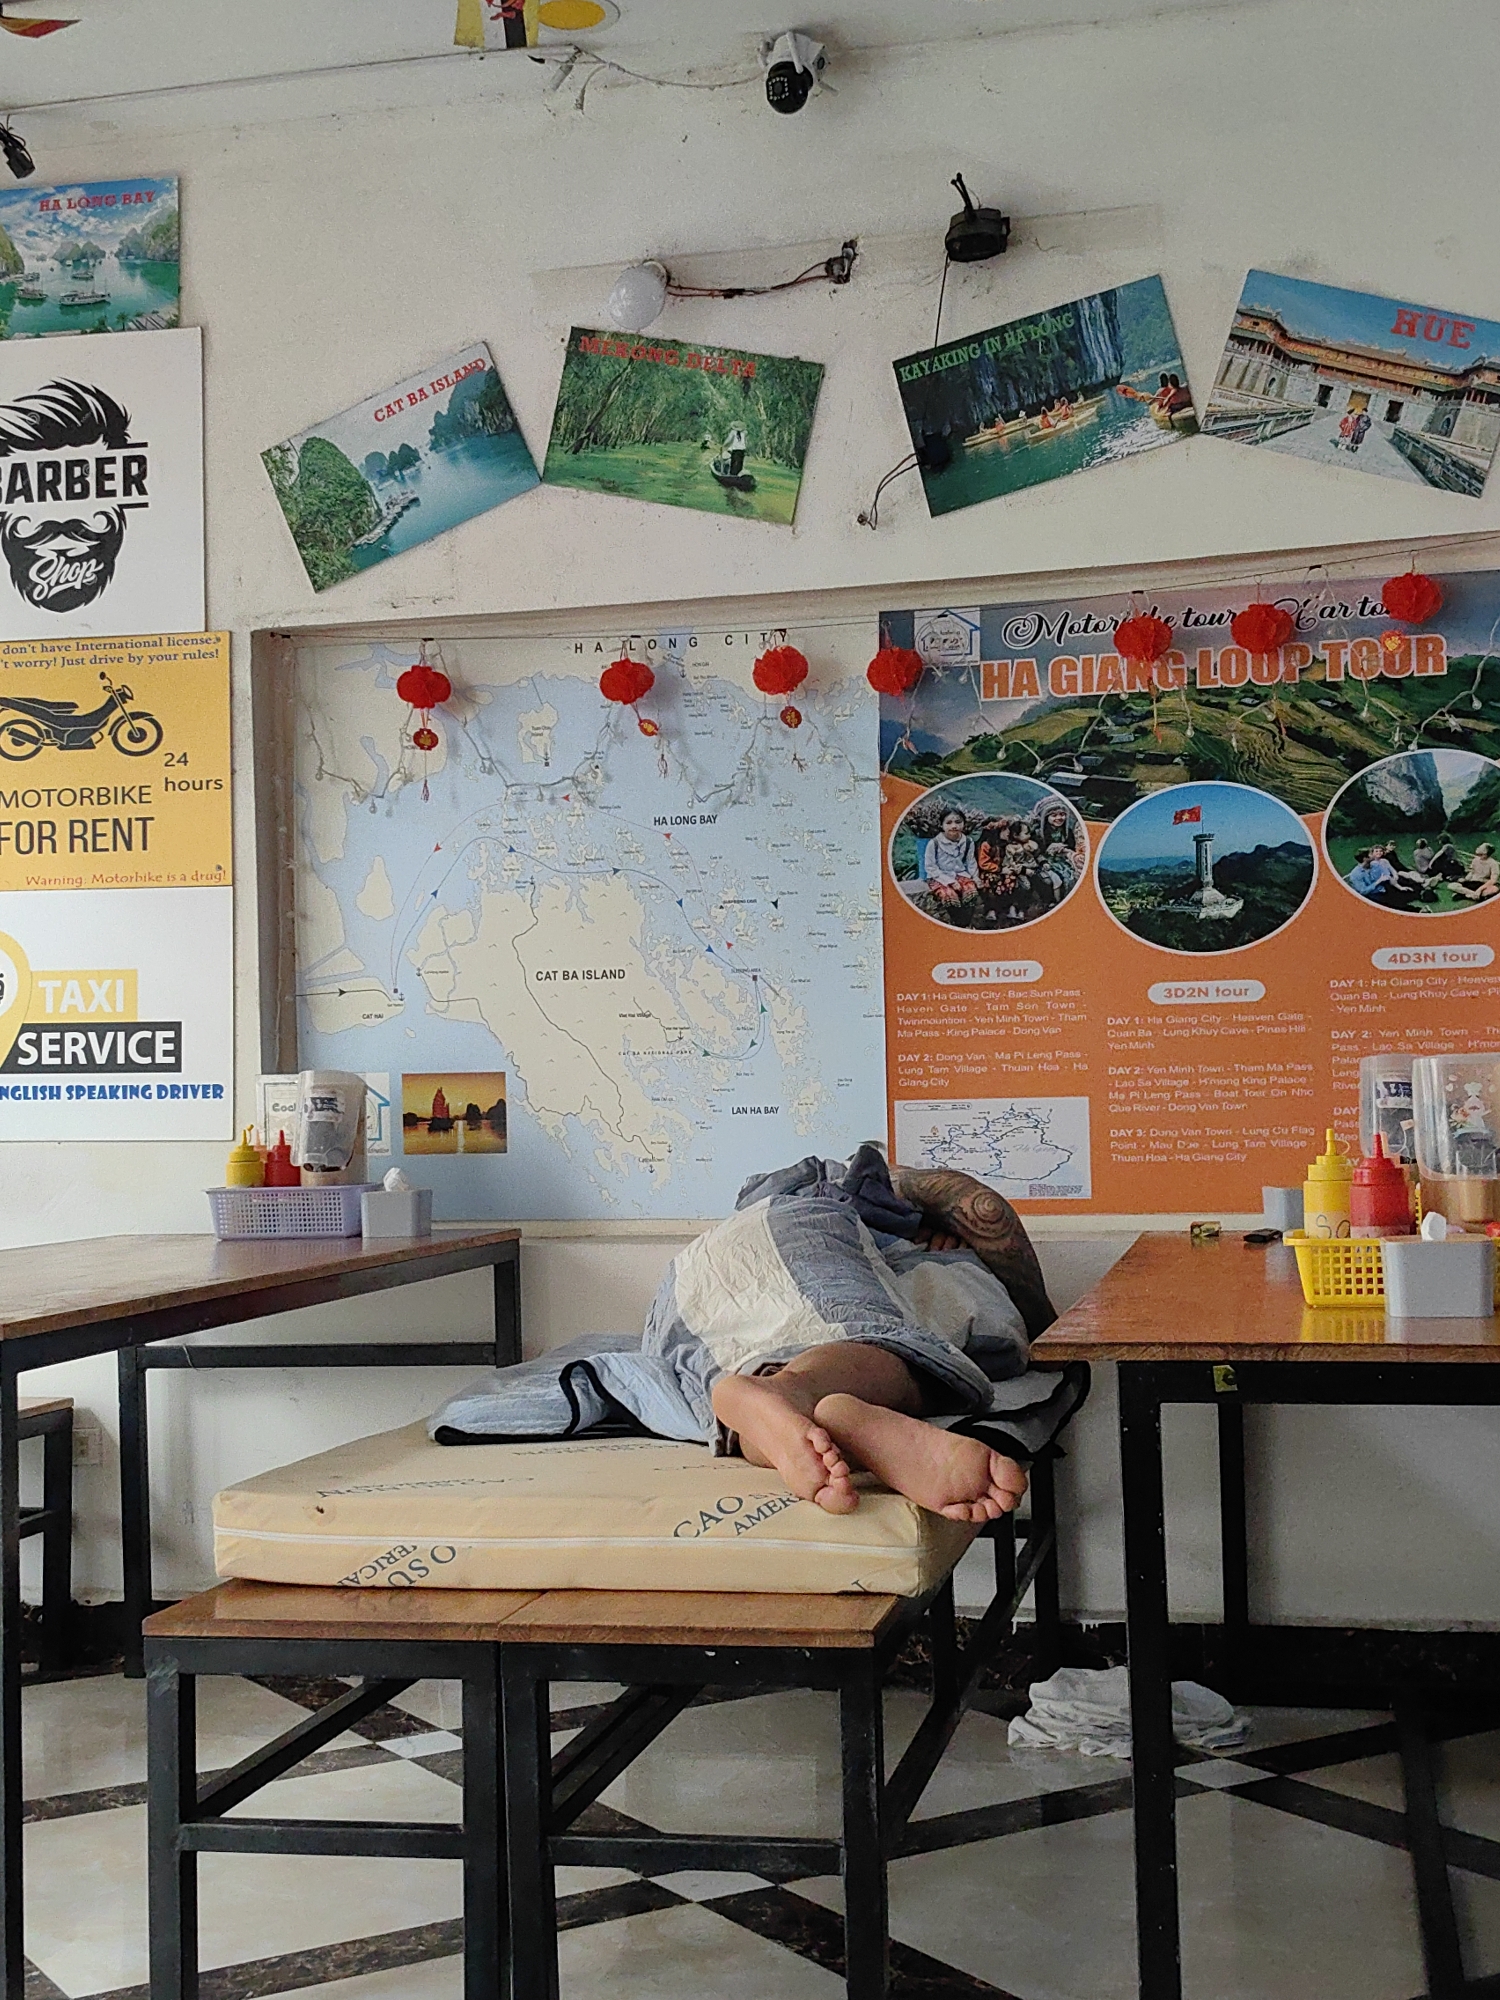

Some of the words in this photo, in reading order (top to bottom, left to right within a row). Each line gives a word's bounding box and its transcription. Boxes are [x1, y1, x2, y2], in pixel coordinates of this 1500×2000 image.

[39, 200, 62, 212] HA
[66, 194, 117, 210] LONG
[121, 190, 155, 205] BAY
[1390, 308, 1476, 349] HUE
[579, 335, 679, 367] MEKONG
[685, 352, 757, 378] DELTA
[899, 343, 981, 383] KAYAKING
[982, 335, 1001, 356] IN
[1003, 328, 1028, 350] HA
[374, 398, 405, 422] CAT
[406, 387, 430, 407] BA
[429, 358, 486, 395] ISLAND
[0, 454, 149, 505] ARBER
[28, 556, 104, 601] Shop
[1181, 606, 1238, 629] tour
[1357, 596, 1391, 618] to
[2, 643, 37, 655] don't
[40, 642, 72, 654] have
[75, 637, 163, 652] International
[574, 642, 604, 653] HA
[629, 636, 699, 651] LONG
[724, 629, 788, 645] CITY
[13, 657, 57, 672] worry!
[60, 656, 86, 668] Just
[89, 654, 124, 666] drive
[128, 653, 144, 665] by
[148, 652, 178, 665] your
[182, 648, 220, 661] rules!
[981, 656, 1041, 701] HA
[1048, 648, 1188, 697] GIANG
[1196, 641, 1313, 690] LOOP
[1319, 633, 1448, 682] TOUR
[164, 753, 189, 767] 24
[164, 777, 224, 792] hours
[0, 785, 152, 809] MOTORBIKE
[653, 816, 668, 826] HA
[670, 815, 697, 826] LONG
[699, 814, 718, 824] BAY
[0, 820, 57, 855] FOR
[69, 816, 155, 854] RENT
[26, 876, 87, 888] Warning:
[92, 870, 163, 884] Motorbike
[167, 872, 178, 883] is
[180, 874, 187, 882] a
[191, 870, 226, 884] drug!
[1387, 952, 1436, 965] 4D3N
[1443, 951, 1479, 963] tour
[535, 970, 559, 981] CAT
[562, 970, 579, 981] BA
[582, 969, 626, 980] ISLAND
[946, 967, 990, 980] 2D1N
[996, 966, 1029, 978] tour
[1329, 979, 1355, 988] DAY
[1371, 978, 1387, 987] Ha
[1426, 976, 1448, 986] City
[38, 979, 124, 1014] TAXI
[896, 993, 919, 1001] DAY
[932, 992, 947, 1001] Ha
[981, 991, 1001, 1001] City
[1055, 988, 1080, 997] Pass
[1163, 986, 1209, 999] 3D2N
[1215, 986, 1250, 998] tour
[1389, 991, 1418, 1000] Lung
[1419, 990, 1448, 999] Khuy
[1450, 988, 1479, 997] Cave
[986, 1002, 1009, 1011] Tam
[1016, 1002, 1039, 1011] Son
[1046, 1001, 1076, 1009] Town
[1336, 1004, 1357, 1013] Yen
[1359, 1004, 1386, 1013] Minh
[996, 1014, 1020, 1023] Minh
[1022, 1014, 1049, 1022] Town
[1058, 1013, 1087, 1021] Tham
[1107, 1016, 1131, 1025] DAY
[1165, 1015, 1198, 1025] Giang
[1200, 1014, 1222, 1024] City
[1232, 1013, 1274, 1022] Heaven
[915, 1029, 940, 1037] Pass
[947, 1028, 969, 1038] King
[971, 1027, 1006, 1036] Palace
[1013, 1026, 1040, 1036] Dong
[1042, 1026, 1062, 1034] Van
[1163, 1027, 1189, 1037] Lung
[1331, 1030, 1356, 1039] DAY
[1361, 1030, 1372, 1039] 2:
[1379, 1029, 1399, 1038] Yen
[1405, 1027, 1433, 1037] Minh
[1439, 1026, 1468, 1036] Town
[17, 1031, 176, 1066] SERVICE
[1107, 1041, 1127, 1050] Yen
[1129, 1041, 1155, 1049] Minh
[1331, 1043, 1359, 1052] Pass
[1372, 1042, 1393, 1051] Lao
[1417, 1041, 1455, 1051] Village
[898, 1053, 920, 1062] DAY
[923, 1053, 933, 1062] 2:
[936, 1053, 963, 1062] Dong
[966, 1052, 985, 1060] Van
[994, 1051, 1011, 1060] Ma
[1027, 1051, 1052, 1060] Leng
[1055, 1050, 1081, 1059] Pass
[898, 1066, 924, 1076] Lung
[954, 1065, 988, 1075] Village
[1108, 1066, 1131, 1075] DAY
[1133, 1066, 1143, 1075] 2:
[1147, 1065, 1166, 1074] Yen
[1169, 1065, 1194, 1074] Minh
[1198, 1064, 1225, 1073] Town
[1233, 1063, 1264, 1072] Tham
[1266, 1063, 1283, 1071] Ma
[898, 1078, 928, 1088] Giang
[930, 1077, 950, 1087] City
[1115, 1079, 1135, 1088] Lao
[1242, 1076, 1267, 1086] King
[0, 1085, 61, 1101] NGLISH
[66, 1084, 152, 1100] SPEAKING
[157, 1083, 224, 1100] DRIVER
[731, 1106, 748, 1115] LAN
[750, 1106, 762, 1115] HA
[763, 1106, 780, 1114] BAY
[1133, 1103, 1160, 1112] River
[1168, 1102, 1197, 1112] Dong
[1198, 1102, 1219, 1111] Van
[1222, 1101, 1248, 1110] Town
[1109, 1128, 1134, 1137] DAY
[1181, 1127, 1202, 1136] Van
[1204, 1127, 1232, 1136] Town
[1242, 1126, 1270, 1137] Lung
[1110, 1140, 1137, 1150] Point
[1211, 1139, 1239, 1150] Lung
[1175, 1152, 1190, 1161] Ha
[1226, 1152, 1247, 1162] City
[673, 1495, 743, 1538] CAO
[732, 1496, 803, 1536] AMER
[336, 1544, 419, 1588] ERICA
[387, 1557, 430, 1588] SU
